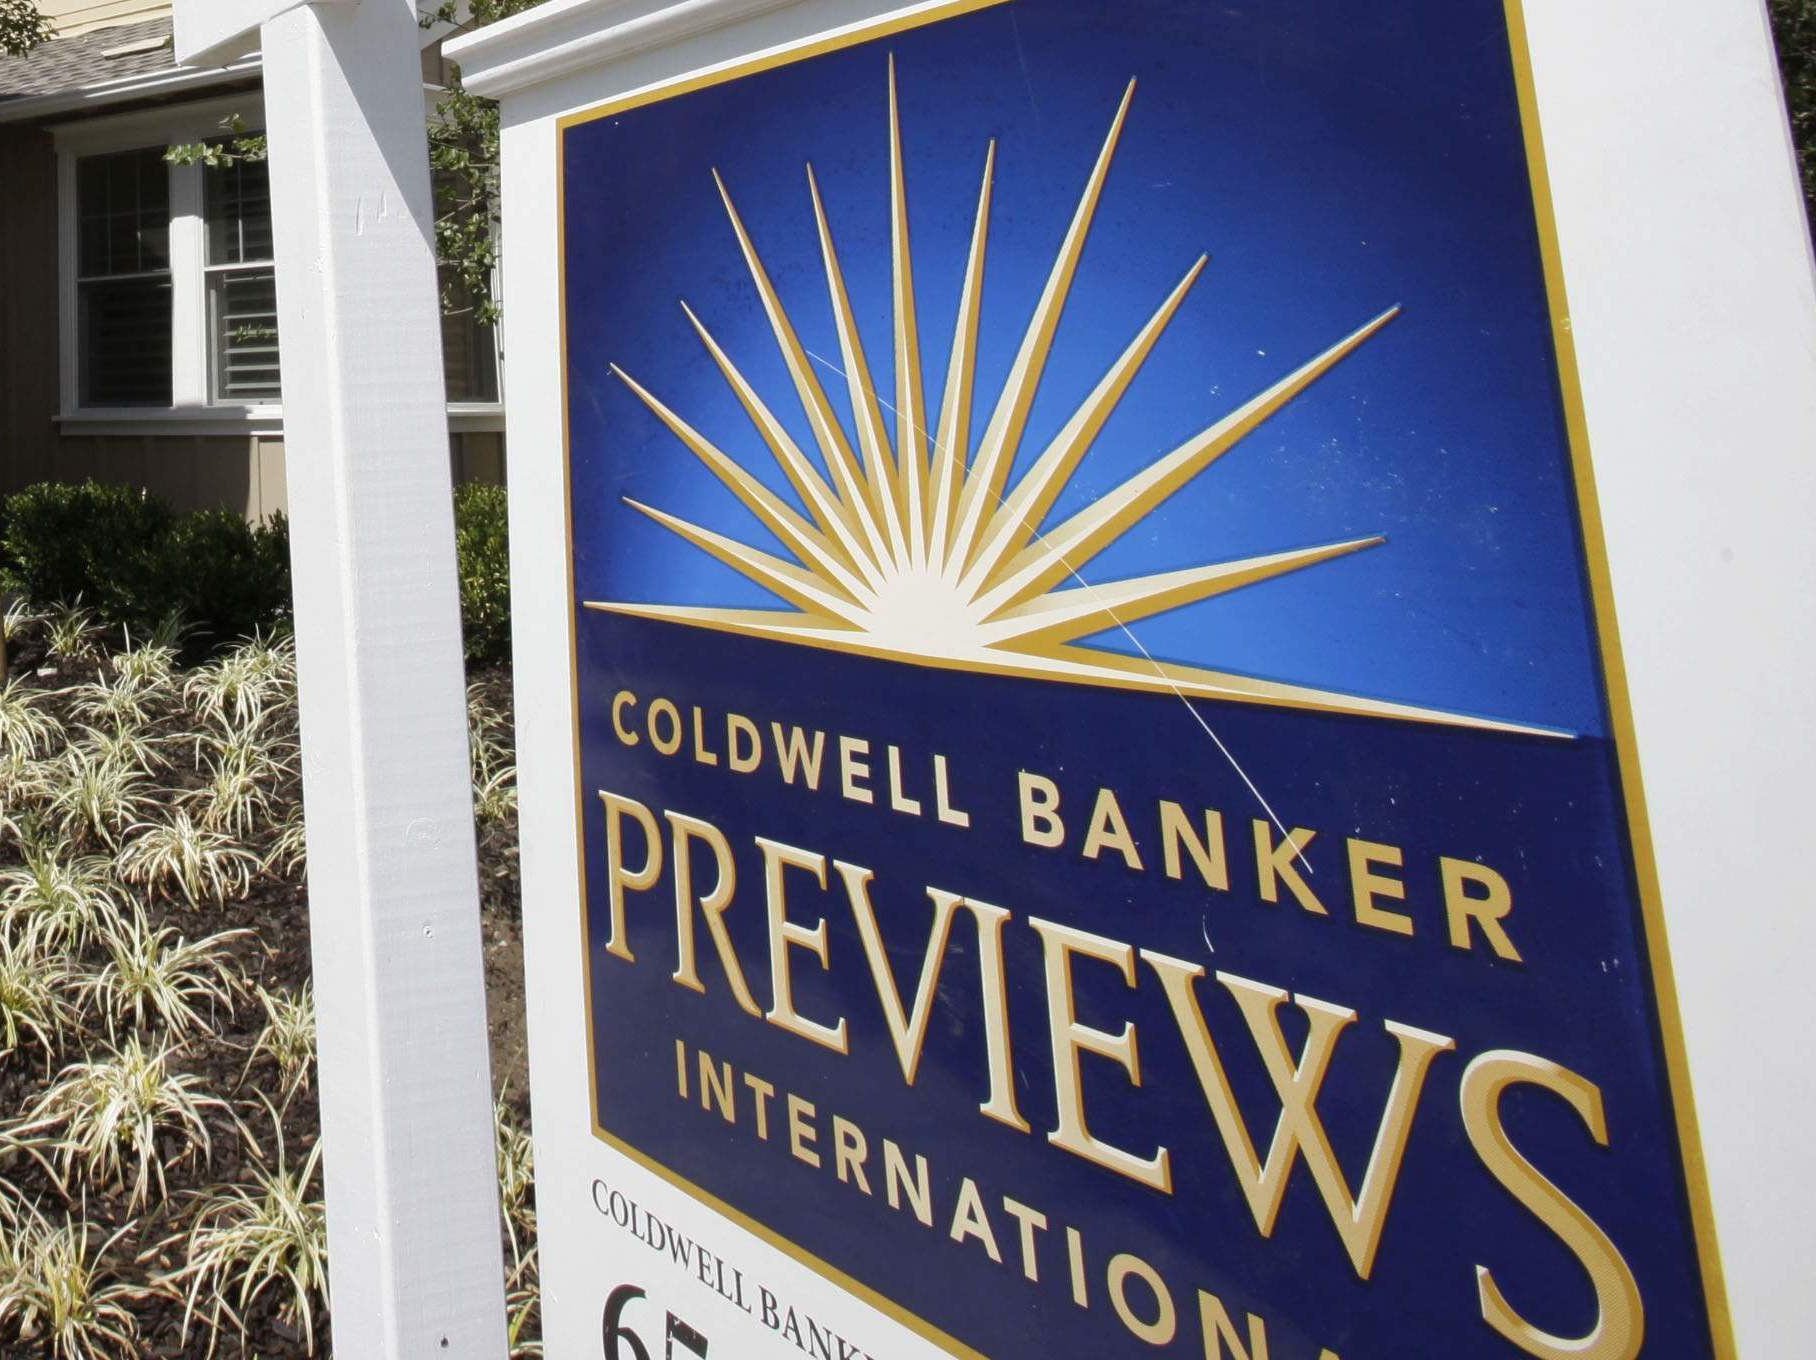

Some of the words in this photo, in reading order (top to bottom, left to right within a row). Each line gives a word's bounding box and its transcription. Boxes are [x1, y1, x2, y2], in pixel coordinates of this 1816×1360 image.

[611, 691, 969, 828] COLDWELL
[1019, 772, 1524, 961] BANKER
[599, 789, 1644, 1360] PREVIEWS
[675, 1038, 1341, 1360] INTERNATION
[591, 1178, 752, 1314] COLDWELL
[758, 1284, 874, 1360] BANK
